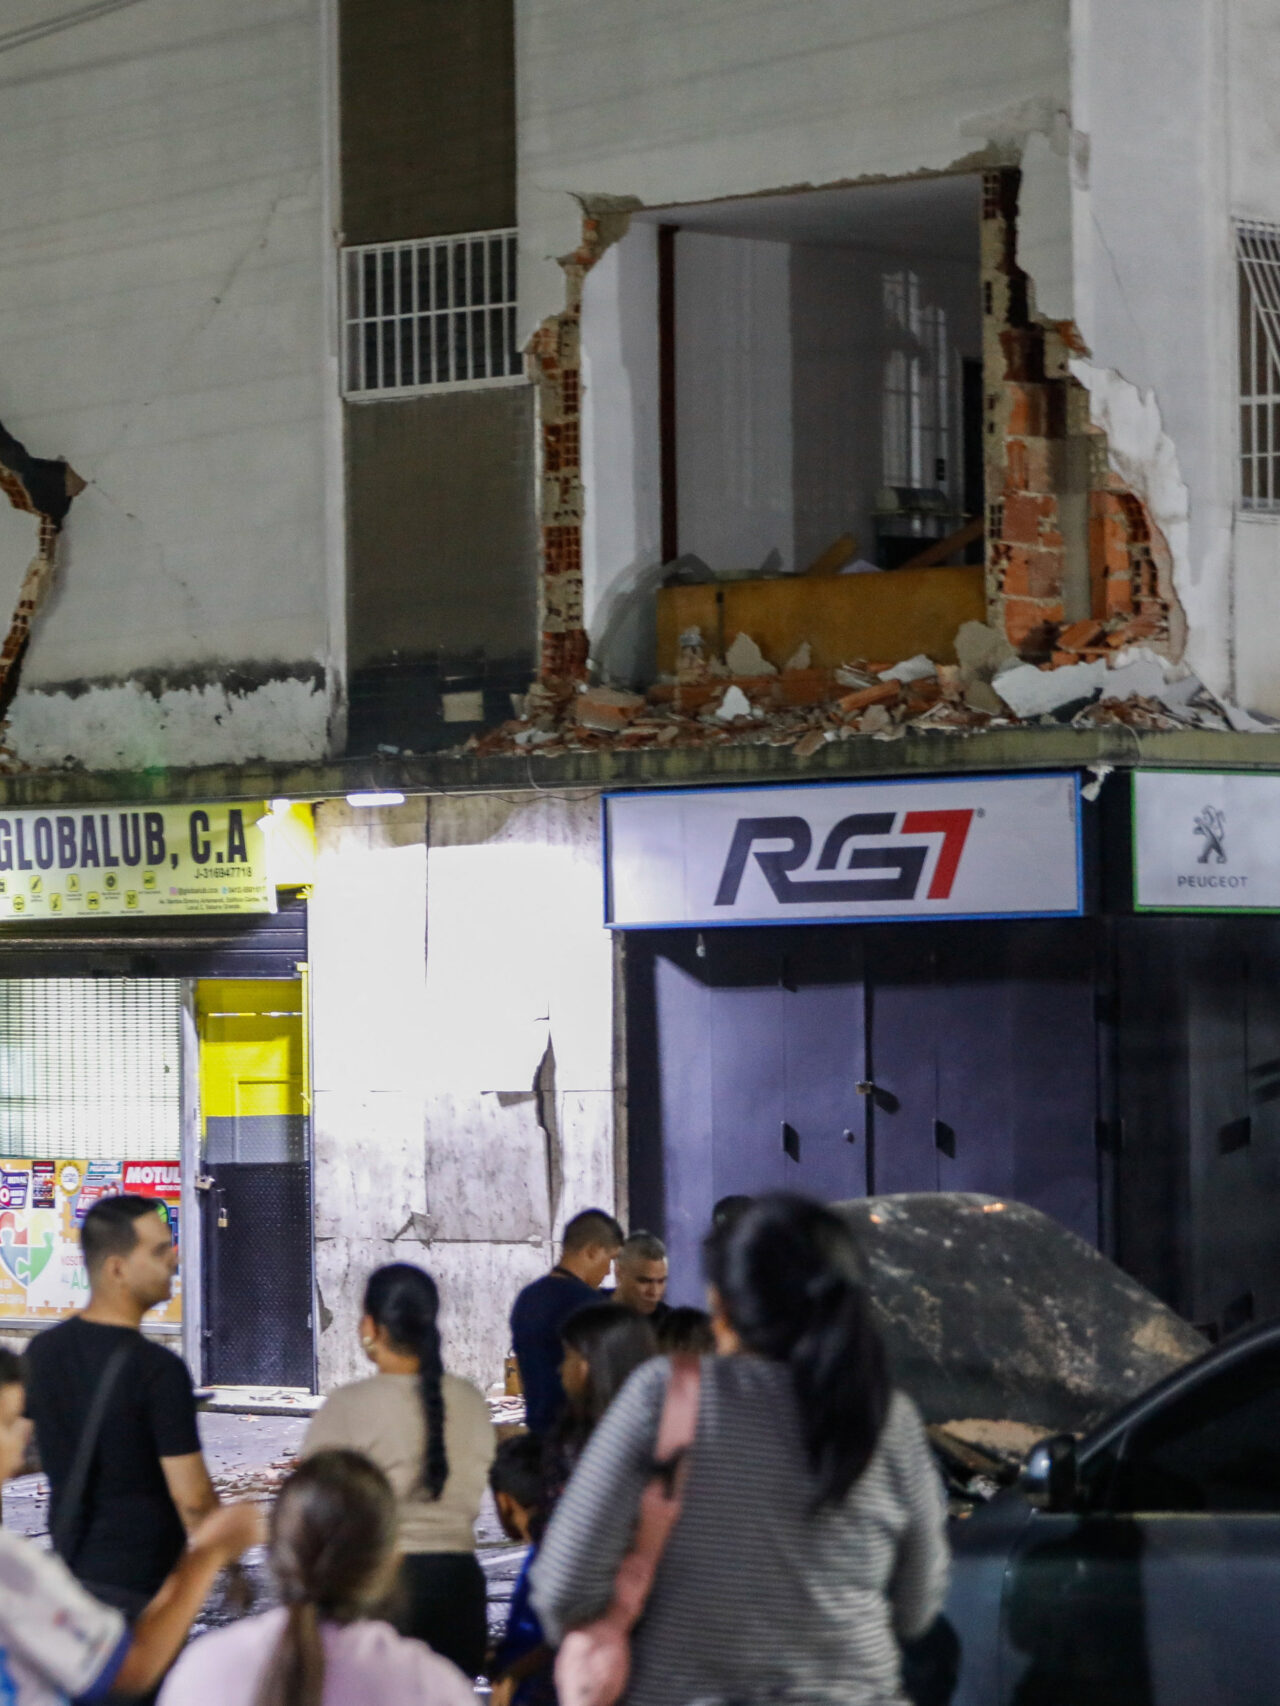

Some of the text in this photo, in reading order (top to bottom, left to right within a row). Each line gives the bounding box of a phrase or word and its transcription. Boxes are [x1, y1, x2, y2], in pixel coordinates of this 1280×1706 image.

[190, 809, 248, 865] C.A
[713, 808, 975, 906] RG7
[1177, 874, 1249, 889] PEUGEOT
[125, 1166, 182, 1184] MOTUL
